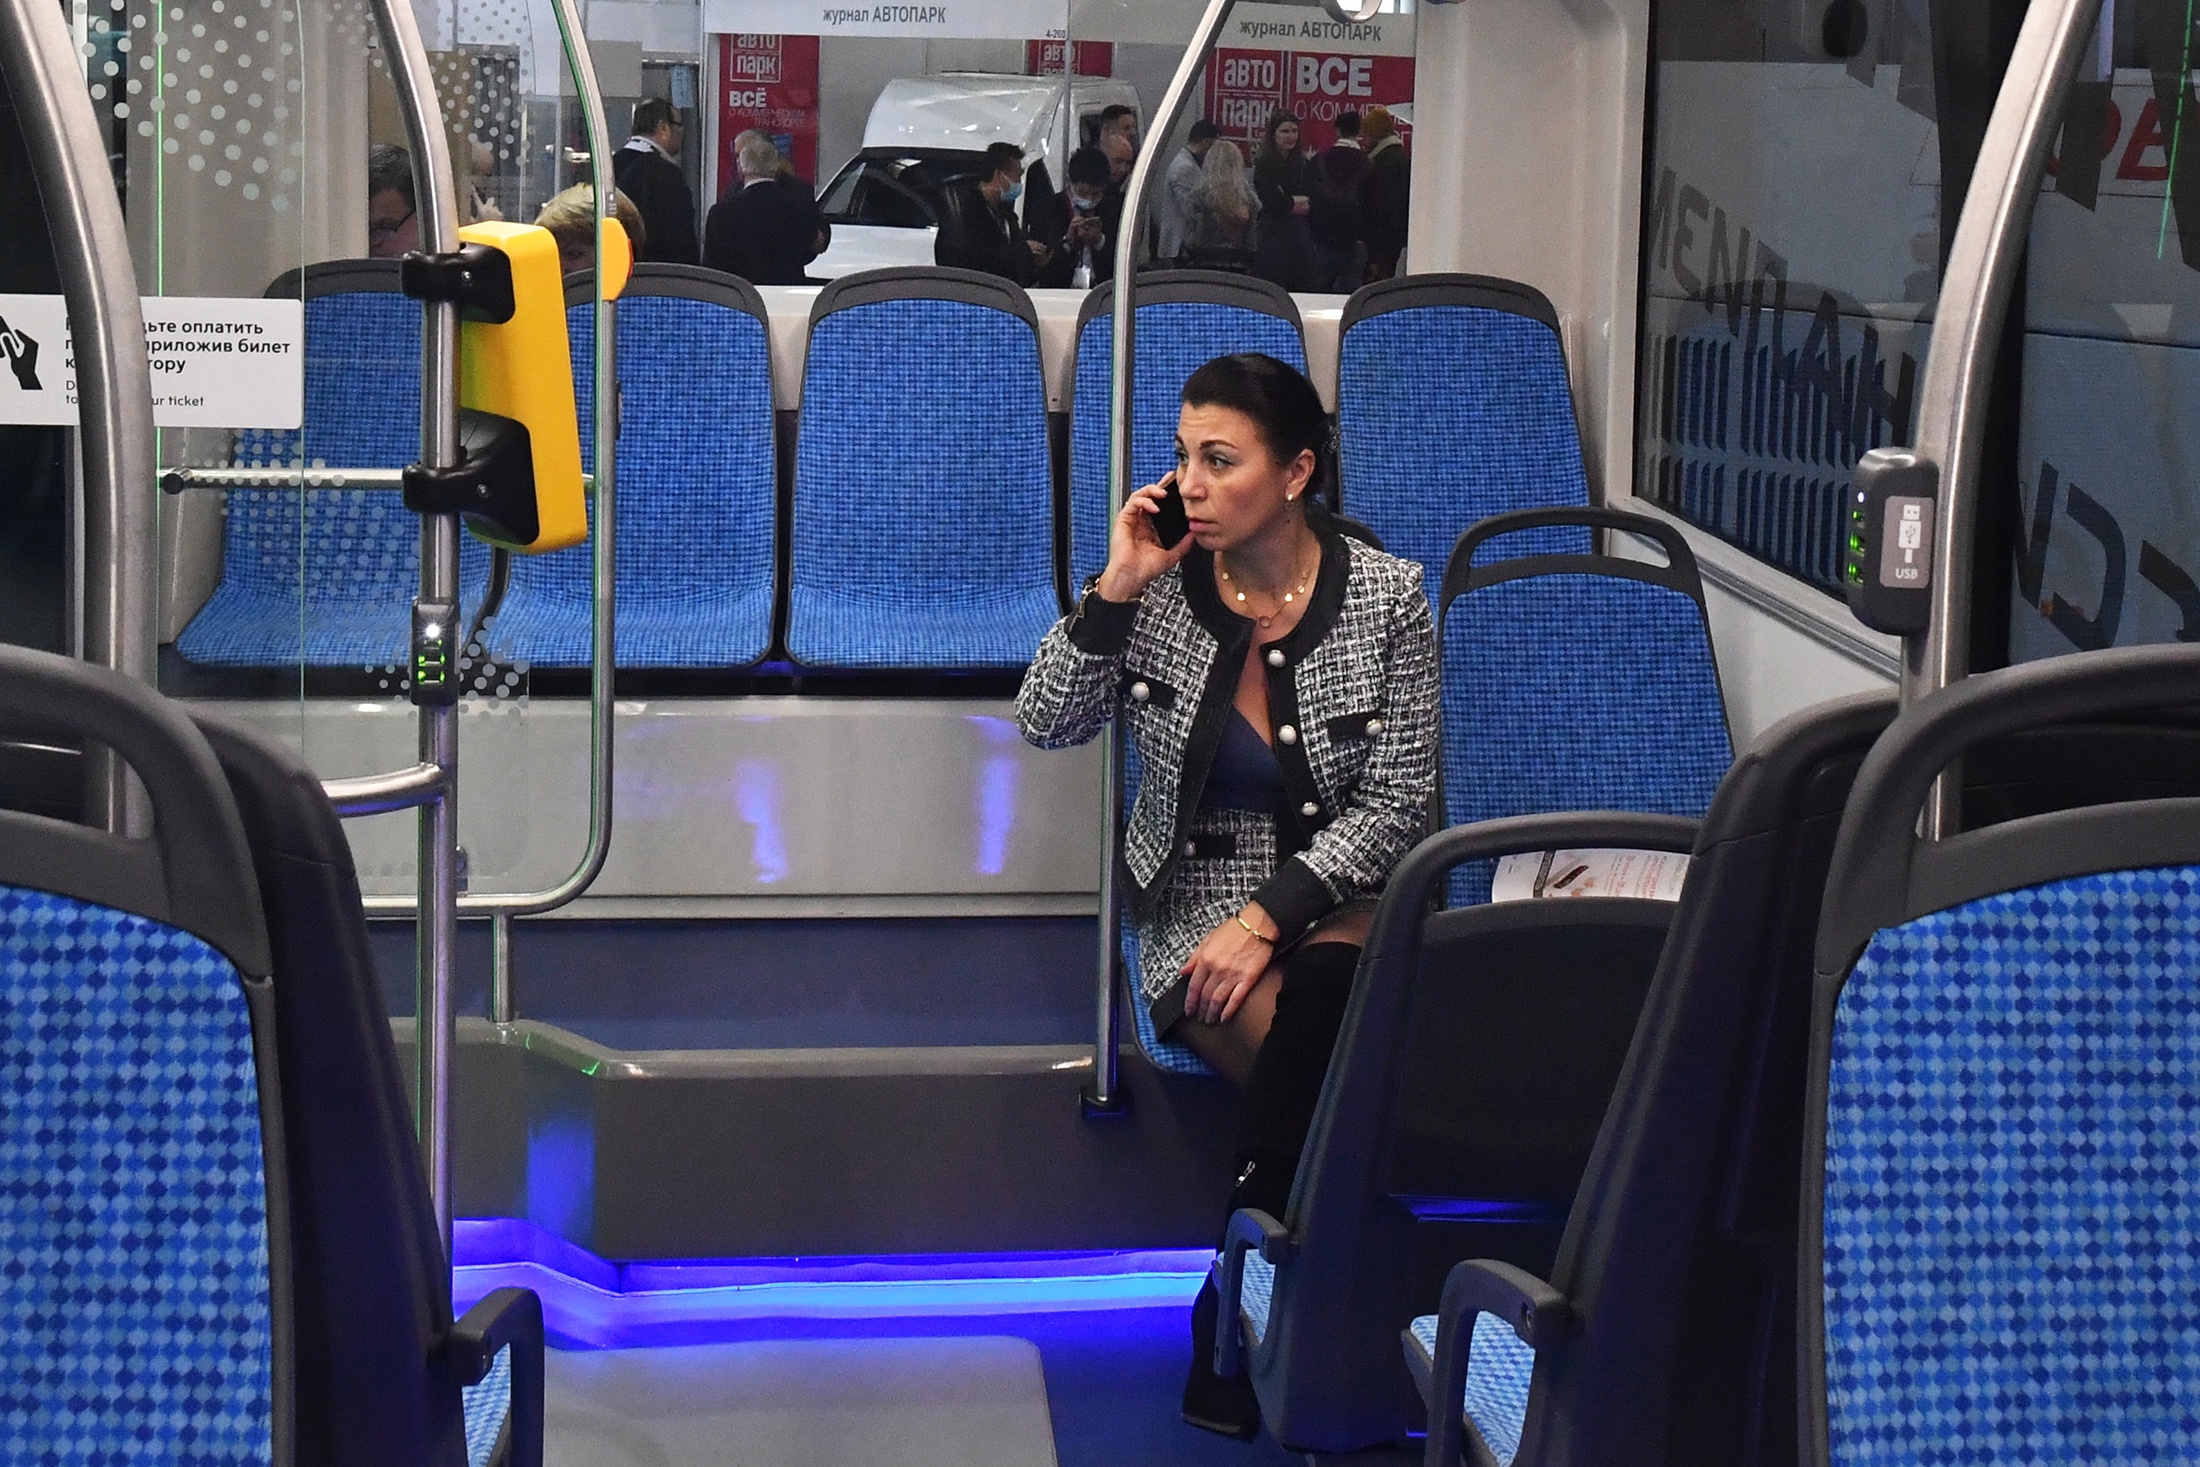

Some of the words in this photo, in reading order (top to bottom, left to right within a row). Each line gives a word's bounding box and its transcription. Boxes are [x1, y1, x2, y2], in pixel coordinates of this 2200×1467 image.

[823, 7, 869, 24] журнал
[872, 6, 946, 24] АВТОПАРК
[1240, 20, 1296, 38] журнал
[1299, 21, 1381, 41] АВТОПАРК
[736, 54, 776, 81] парк
[1223, 58, 1276, 89] авто
[1295, 56, 1373, 96] ВСЕ
[729, 87, 767, 108] ВСЁ
[1222, 98, 1276, 137] парк
[182, 322, 264, 335] оплатить
[238, 338, 290, 354] билет
[168, 395, 204, 406] ticket
[1895, 568, 1918, 579] USB
